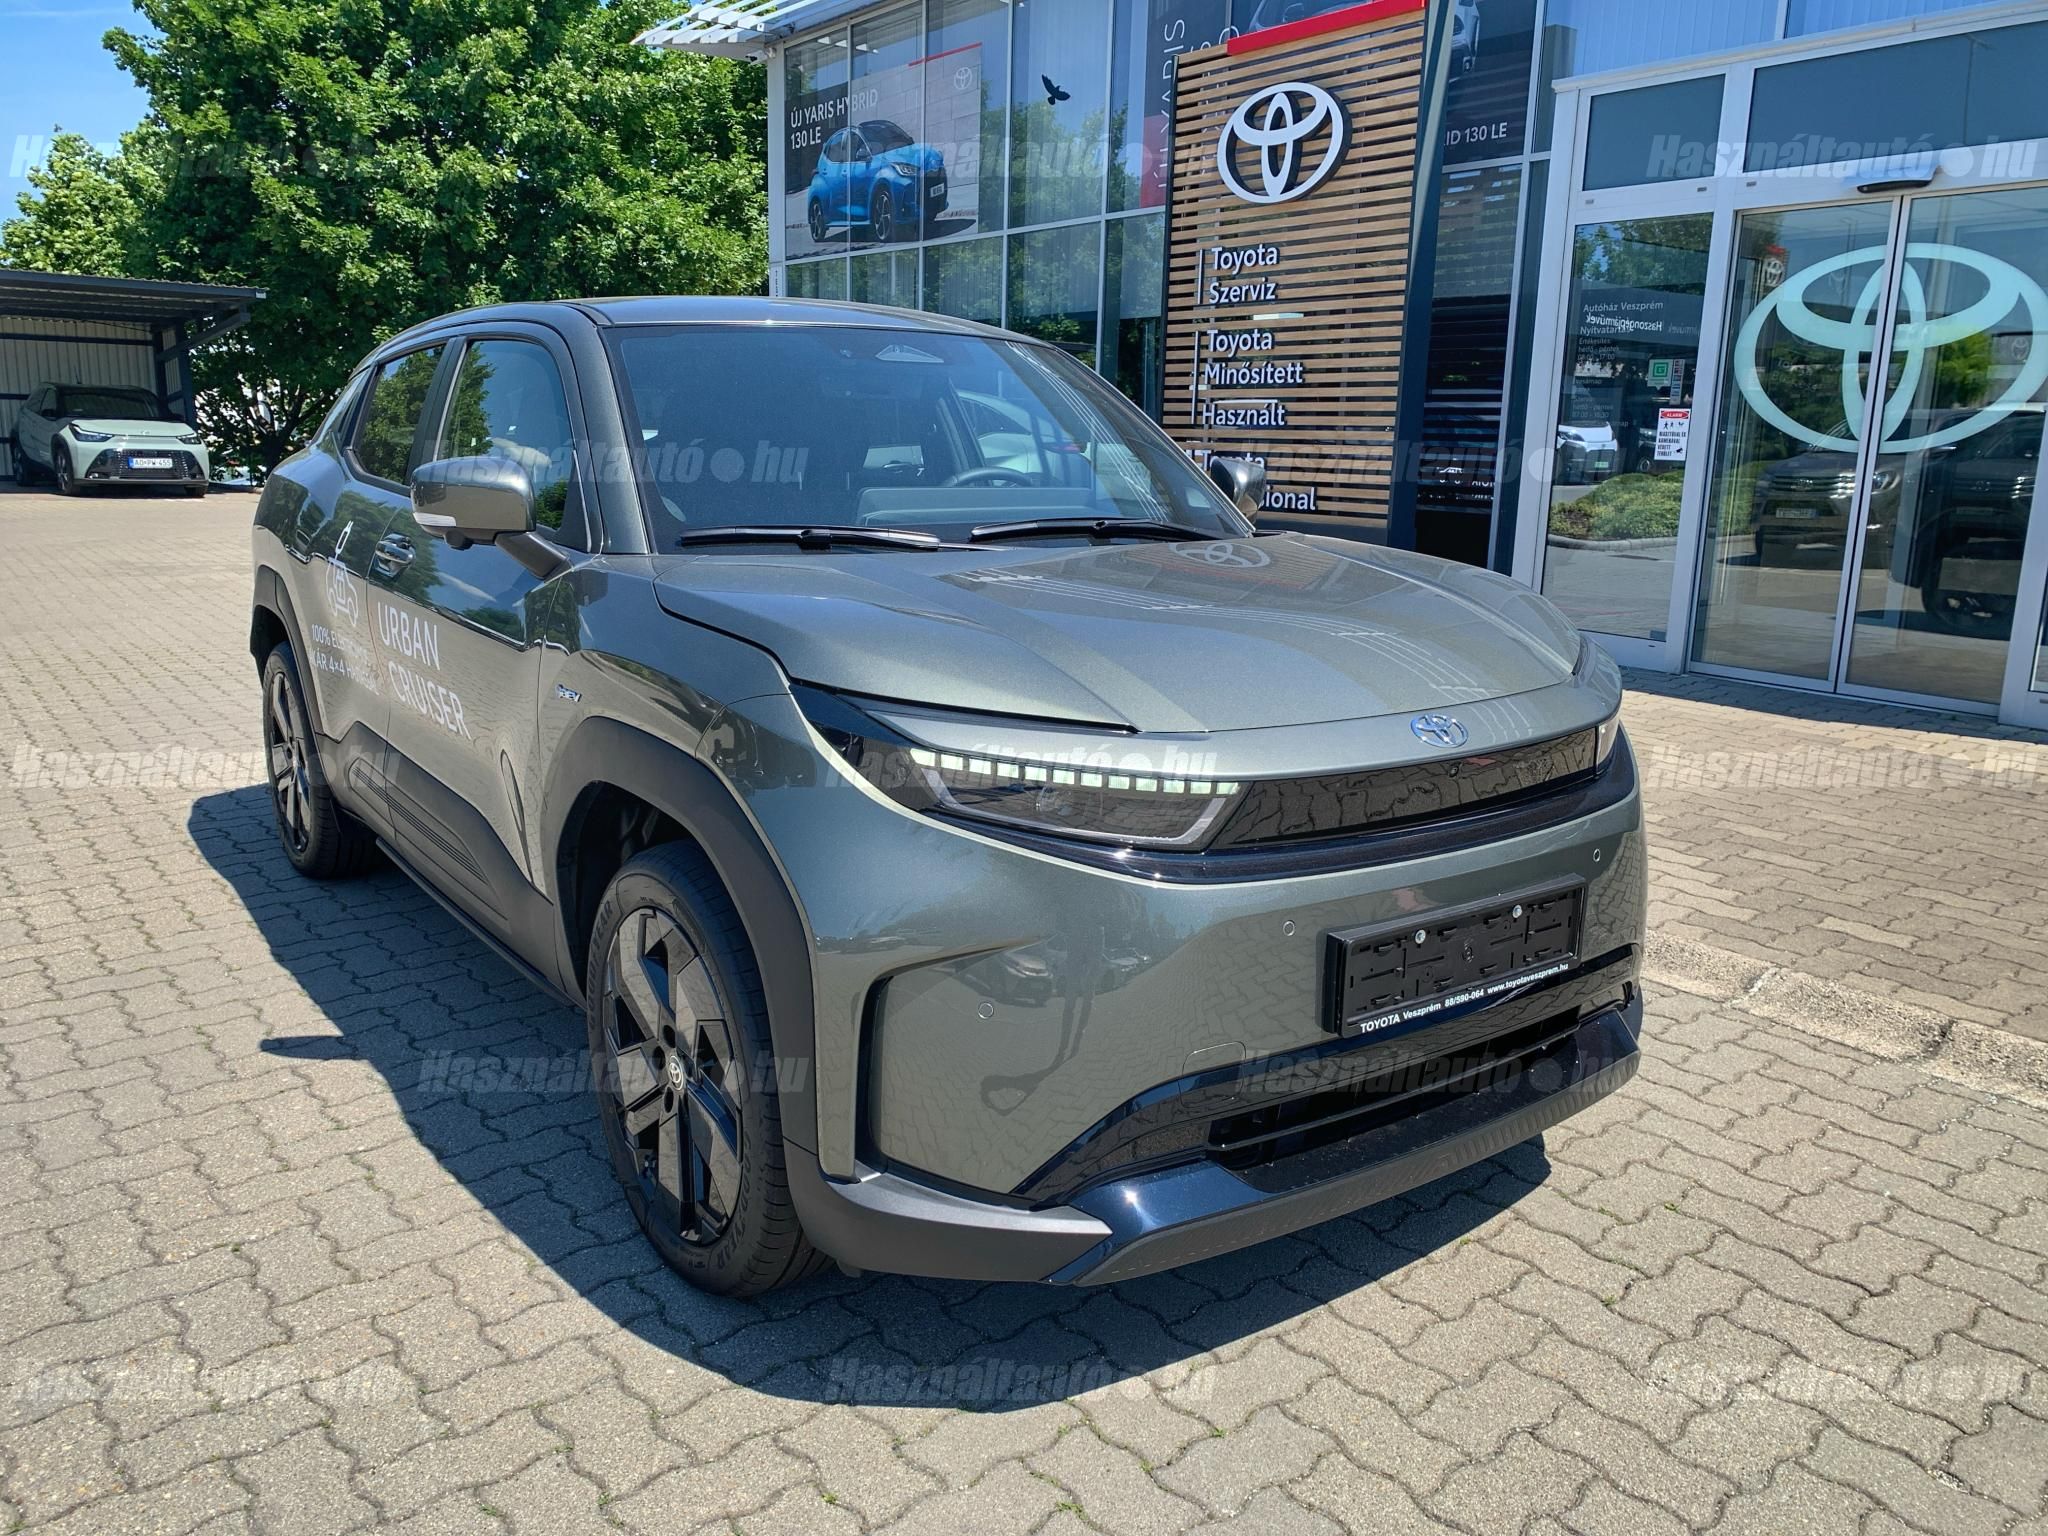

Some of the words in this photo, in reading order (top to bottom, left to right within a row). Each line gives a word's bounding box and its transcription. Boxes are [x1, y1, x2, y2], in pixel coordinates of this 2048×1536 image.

[790, 107, 802, 128] ÚJ
[804, 100, 834, 124] YARIS
[837, 89, 879, 114] HYBRID
[790, 130, 808, 149] 130
[809, 126, 822, 145] LE
[1444, 129, 1461, 146] ID
[1464, 125, 1488, 143] 130
[1491, 122, 1508, 140] LE
[1211, 243, 1278, 275] Toyota
[1209, 277, 1276, 304] Szerviz
[1583, 302, 1618, 313] Autóház
[1621, 300, 1664, 312] Veszprém
[1207, 328, 1273, 358] Toyota
[1204, 361, 1303, 386] Minősített
[1202, 403, 1286, 426] Használt
[377, 601, 440, 671] URBAN
[388, 660, 471, 740] CRUISER
[1360, 1012, 1400, 1034] TOYOTA
[1403, 1002, 1441, 1020] Veszprém
[1444, 988, 1484, 1008] 88/590-064
[1487, 963, 1569, 994] www.toyotaveszprem.hu
